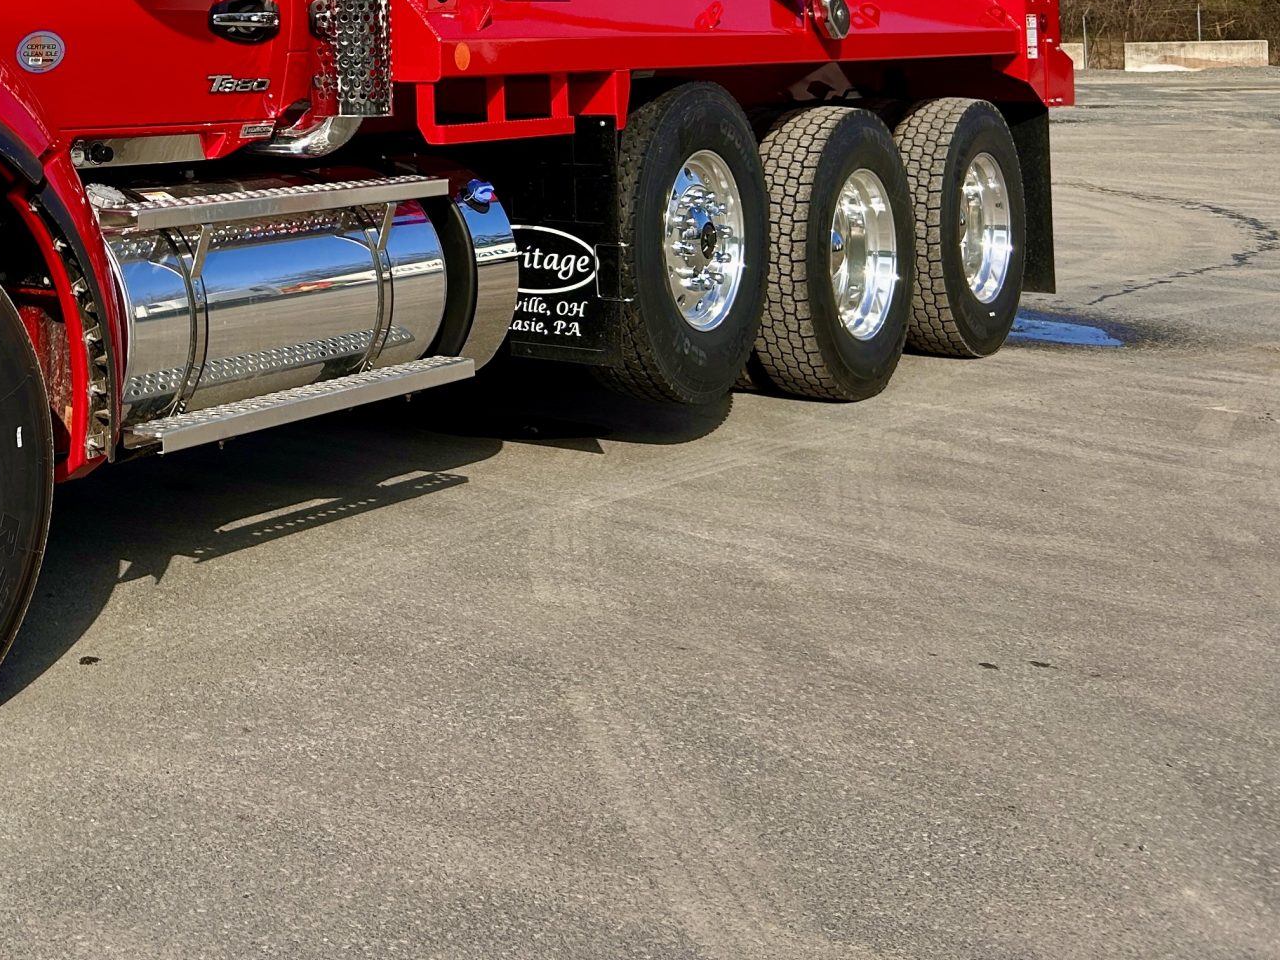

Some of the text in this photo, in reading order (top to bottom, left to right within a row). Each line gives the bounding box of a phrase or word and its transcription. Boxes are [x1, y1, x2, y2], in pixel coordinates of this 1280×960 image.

[517, 244, 590, 280] itage
[556, 300, 589, 318] OH
[508, 317, 582, 337] asie, PA
